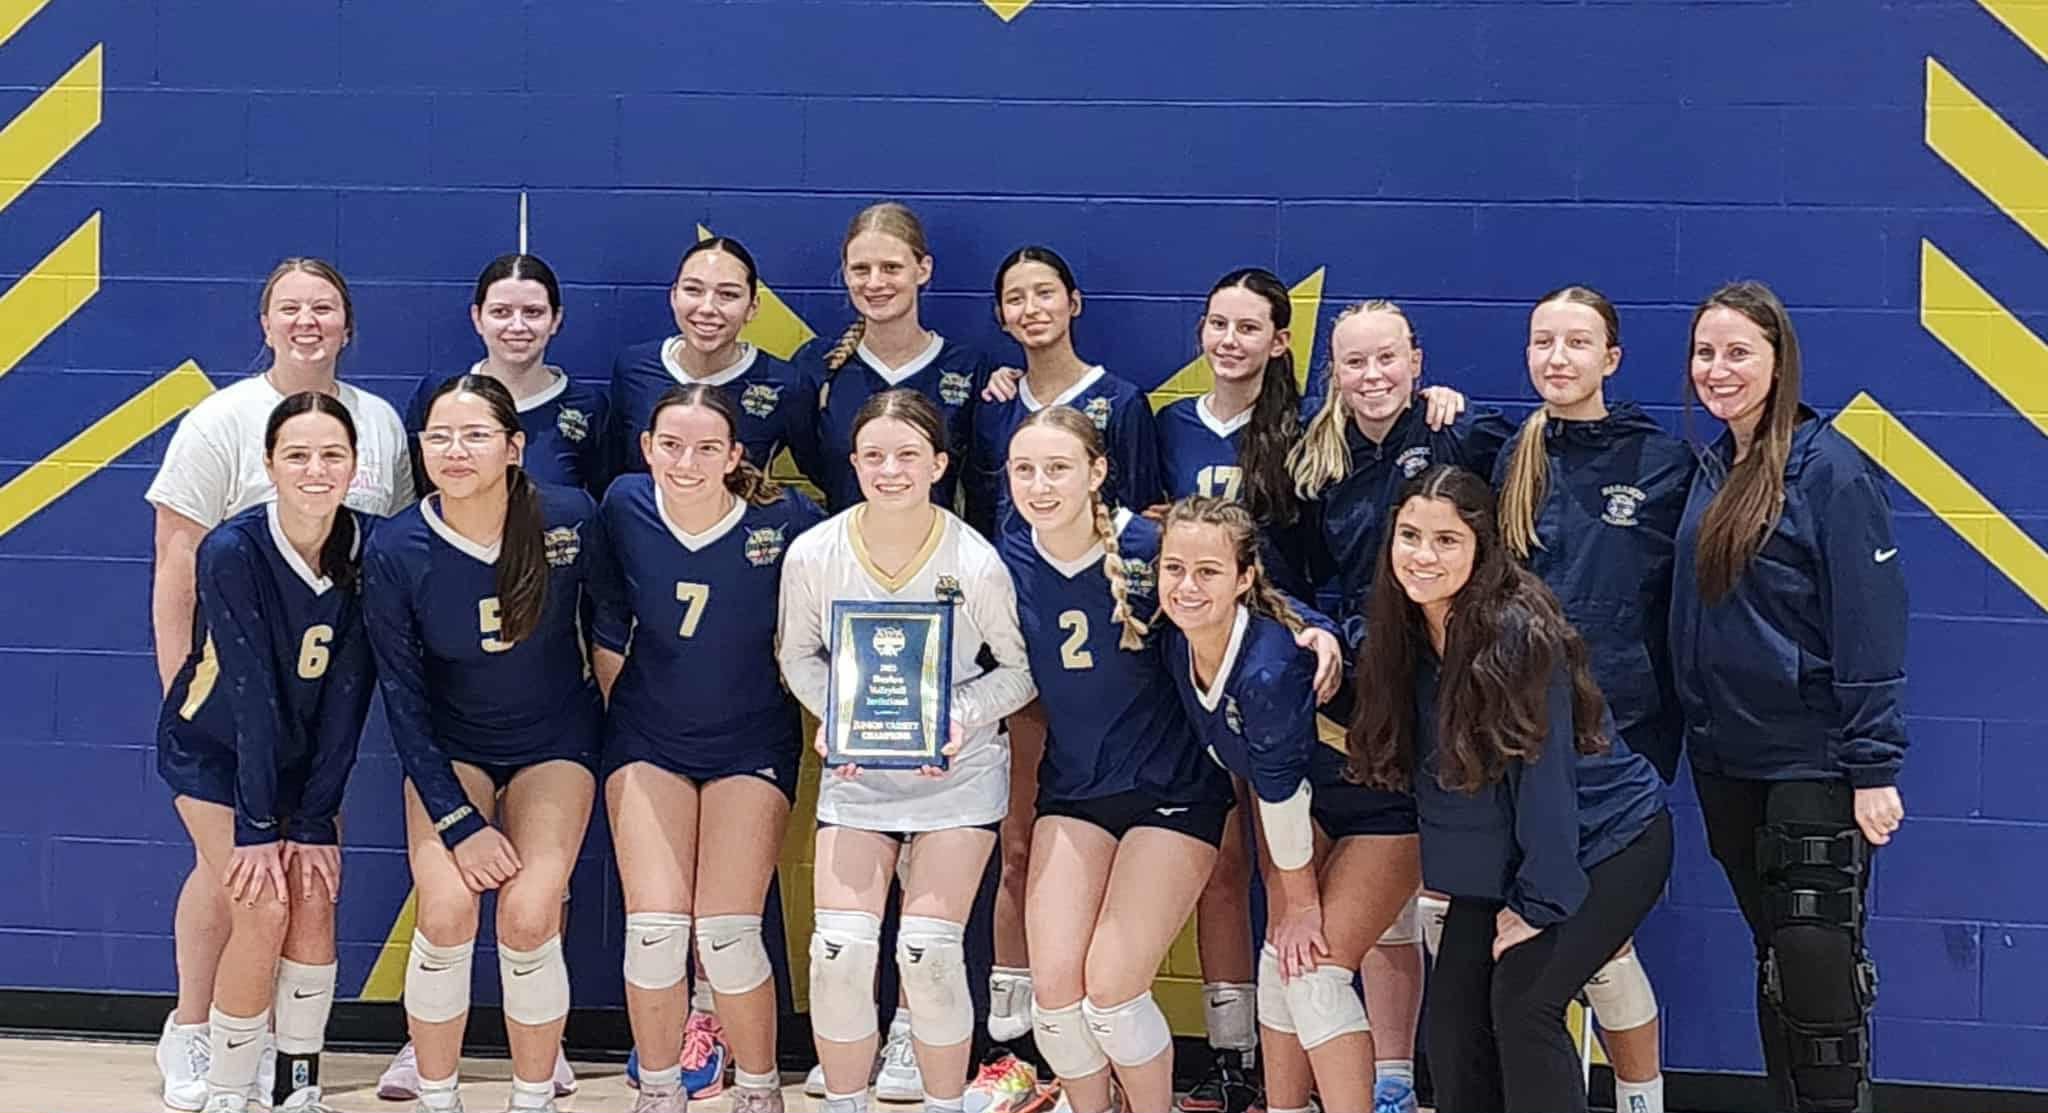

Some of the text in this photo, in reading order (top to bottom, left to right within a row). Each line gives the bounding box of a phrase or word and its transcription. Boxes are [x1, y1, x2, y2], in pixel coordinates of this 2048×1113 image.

[1196, 465, 1243, 502] 17
[479, 597, 513, 652] 5
[675, 583, 709, 637] 7
[296, 625, 333, 679] 6
[1058, 610, 1094, 669] 2
